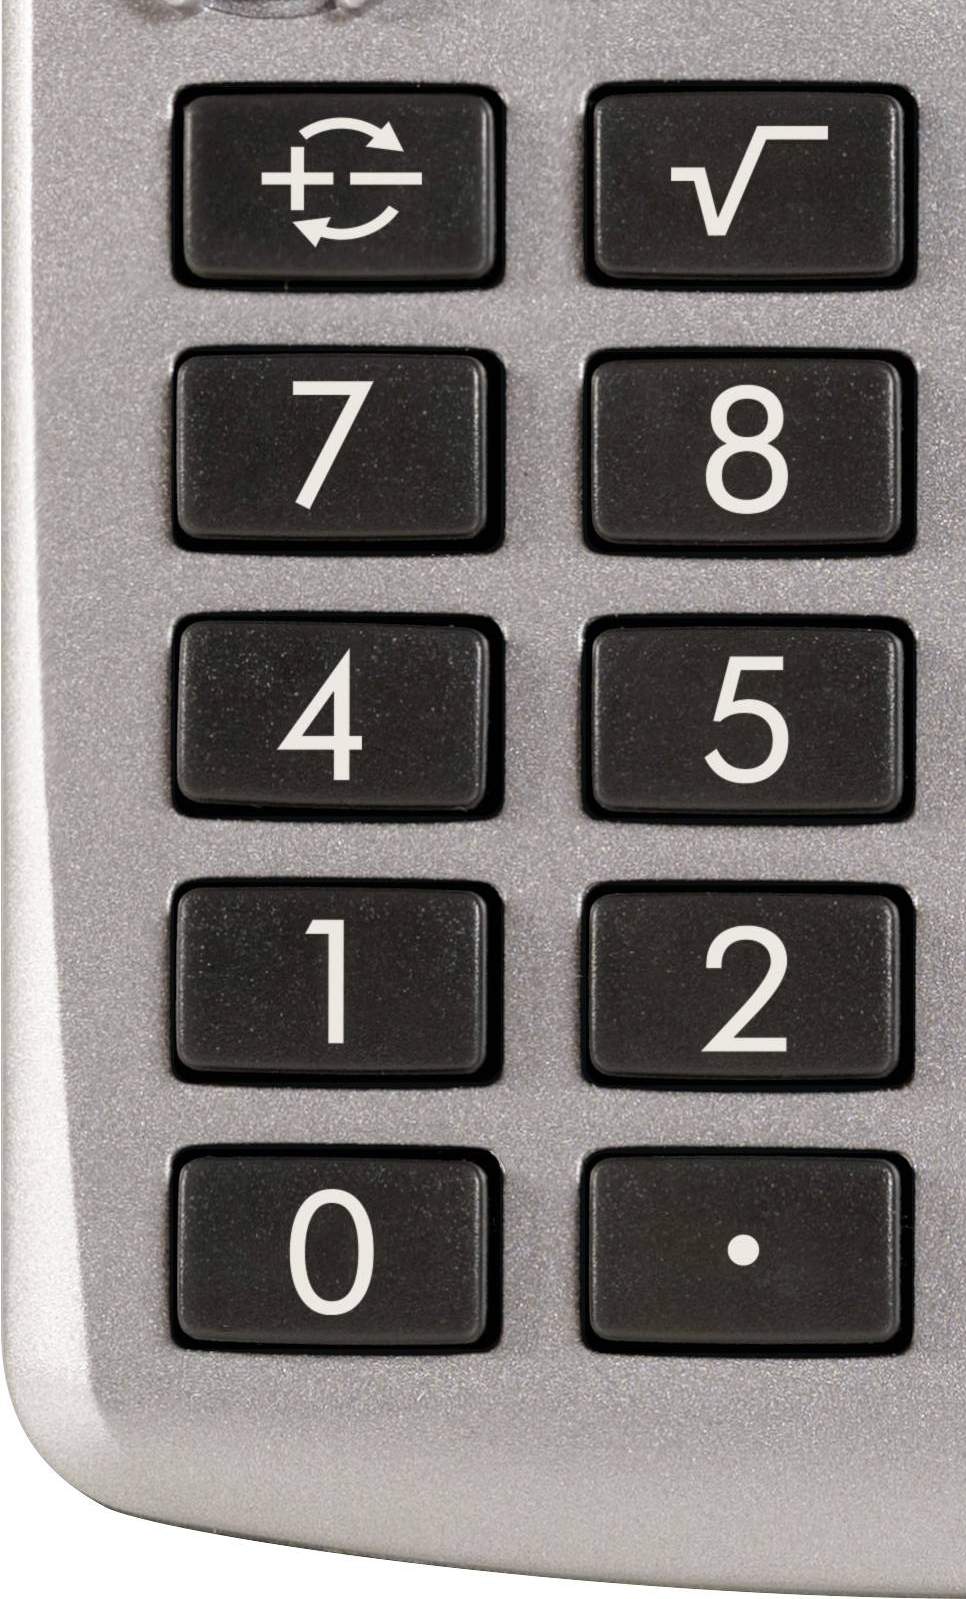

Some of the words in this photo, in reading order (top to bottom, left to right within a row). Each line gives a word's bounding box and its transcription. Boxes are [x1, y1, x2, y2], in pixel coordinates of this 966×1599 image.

[293, 381, 373, 509] 7
[706, 385, 788, 514] 8
[278, 650, 362, 780] 4
[705, 657, 788, 783] 5
[306, 920, 344, 1043] 1
[702, 926, 787, 1051] 2
[290, 1189, 374, 1315] 0
